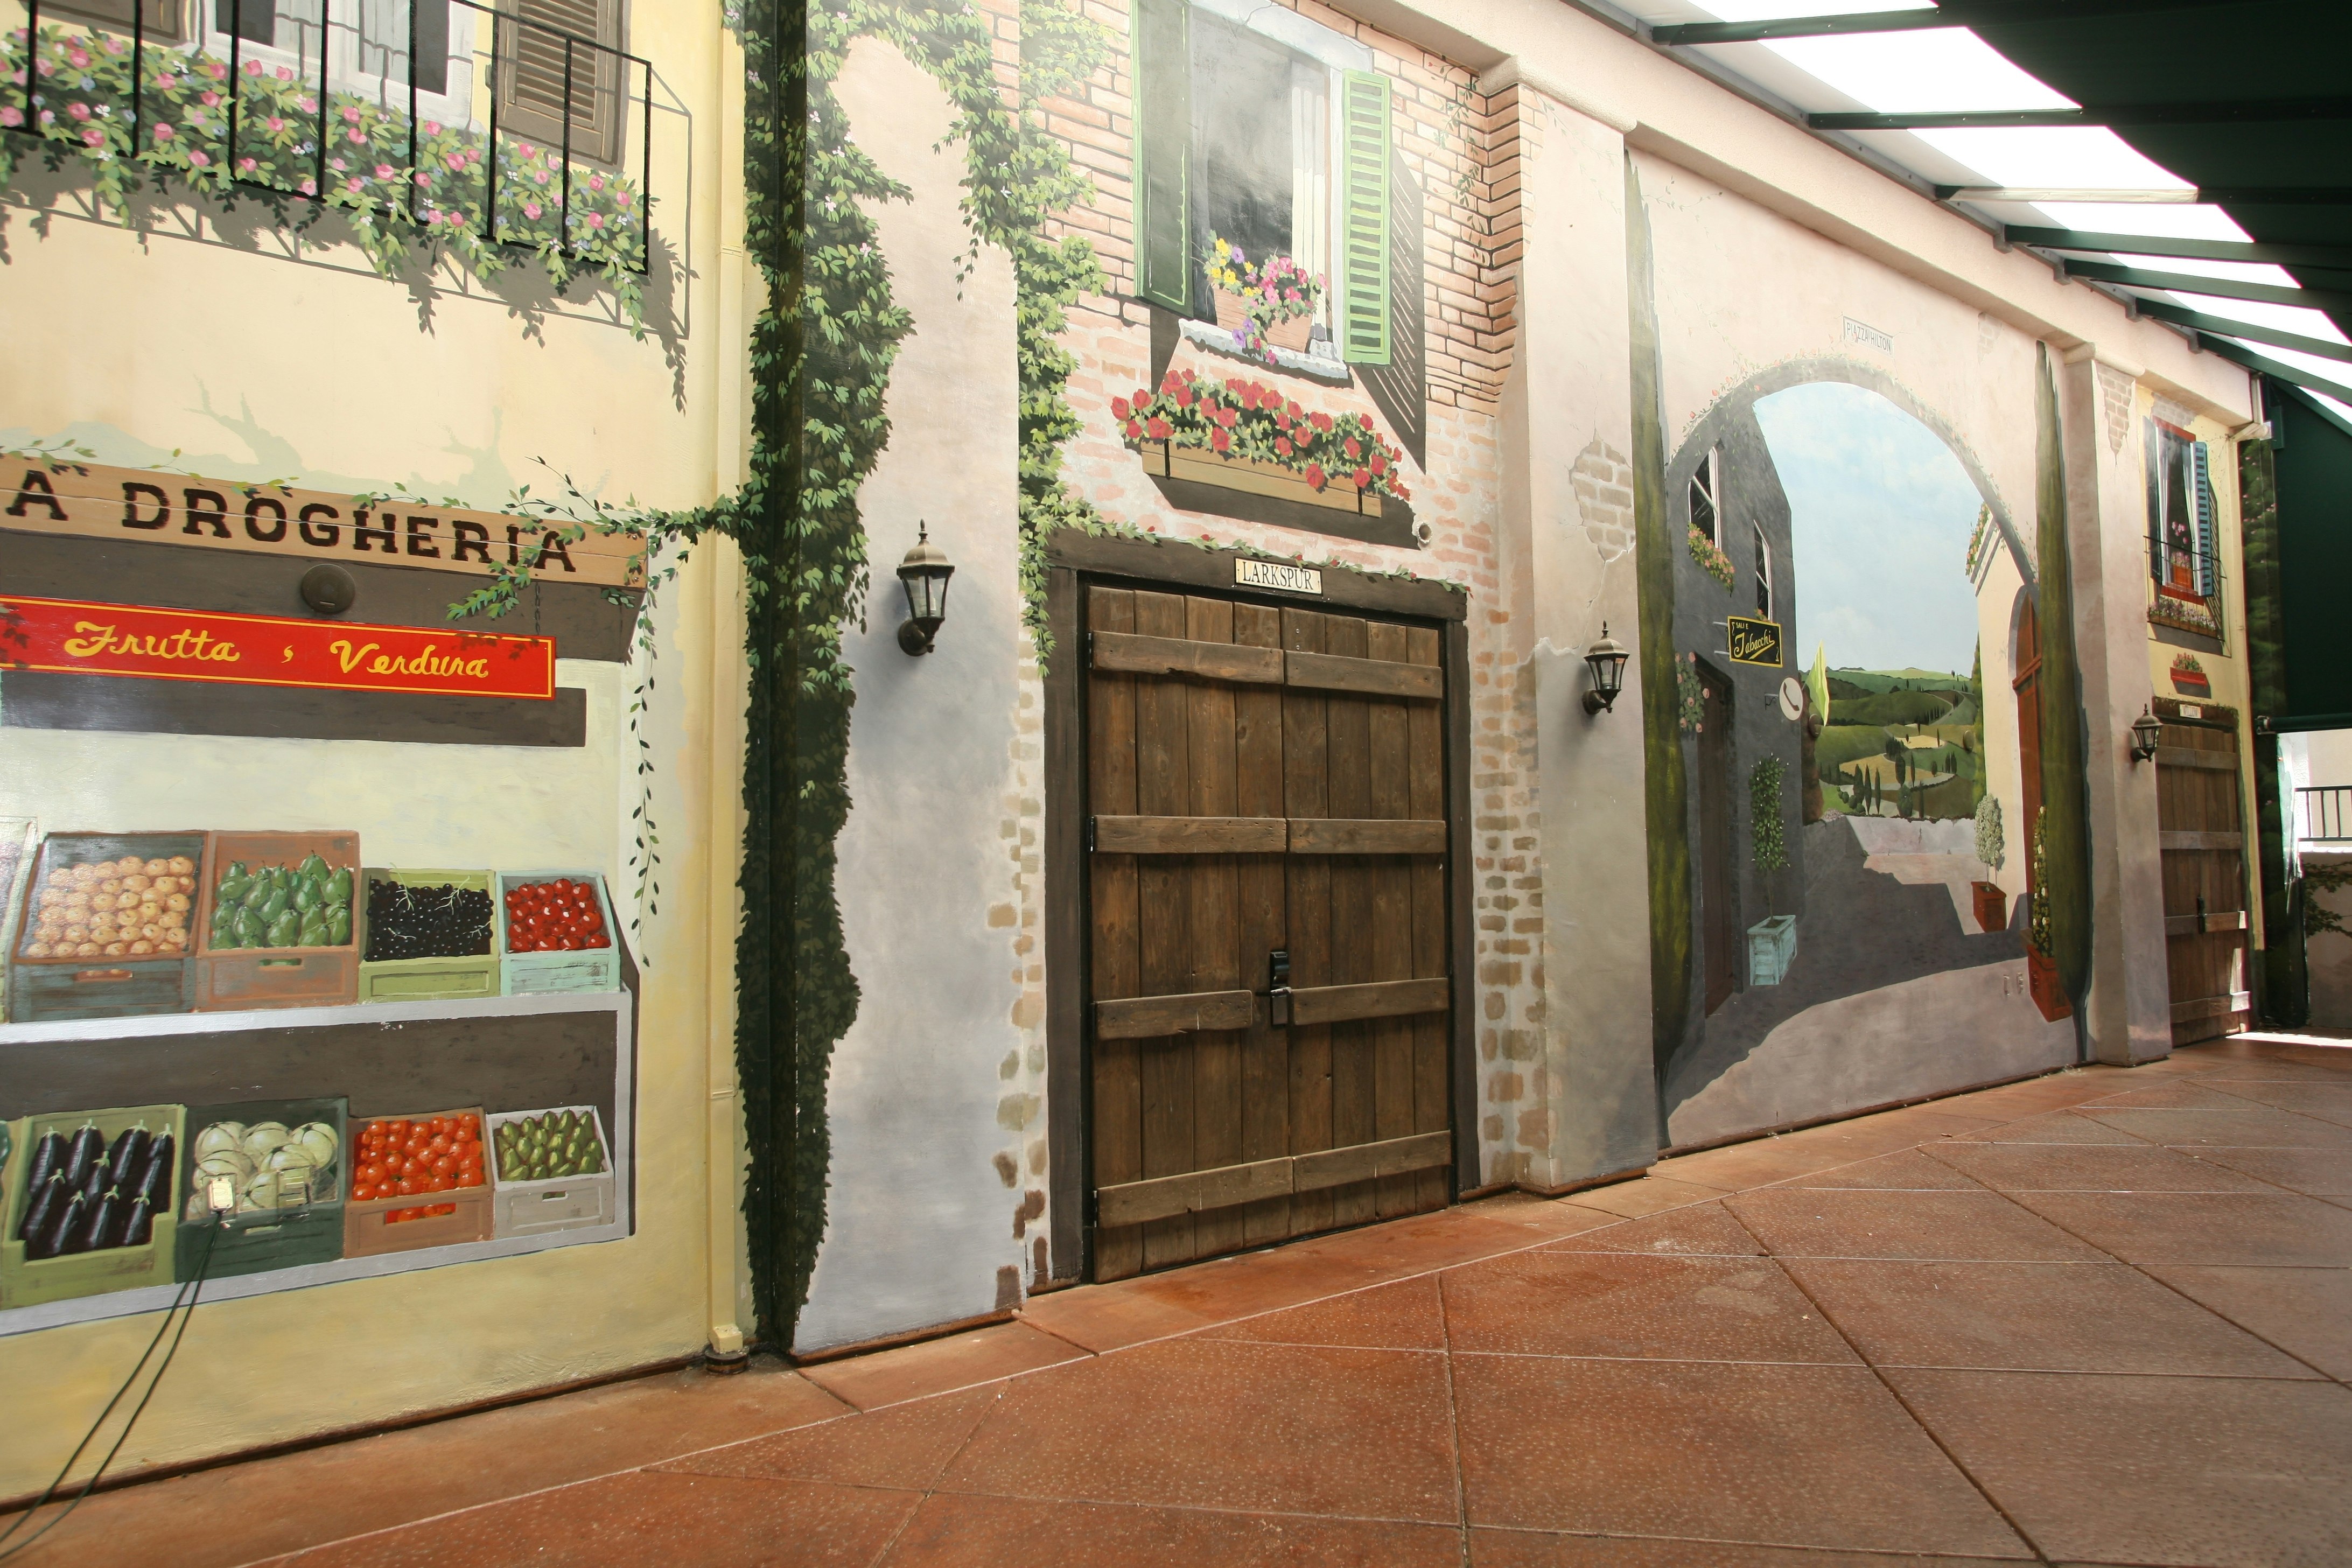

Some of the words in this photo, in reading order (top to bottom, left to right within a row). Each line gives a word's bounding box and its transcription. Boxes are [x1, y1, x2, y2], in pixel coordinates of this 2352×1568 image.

[1846, 322, 1869, 343] PIAZZA
[1870, 331, 1892, 353] HILTON
[6, 470, 69, 521] A
[122, 482, 576, 572] DROGHERIA
[1242, 561, 1314, 590] LARKSPUR
[64, 620, 241, 662] Frutta
[330, 639, 489, 678] Verdura
[1733, 629, 1775, 659] Tabacchi
